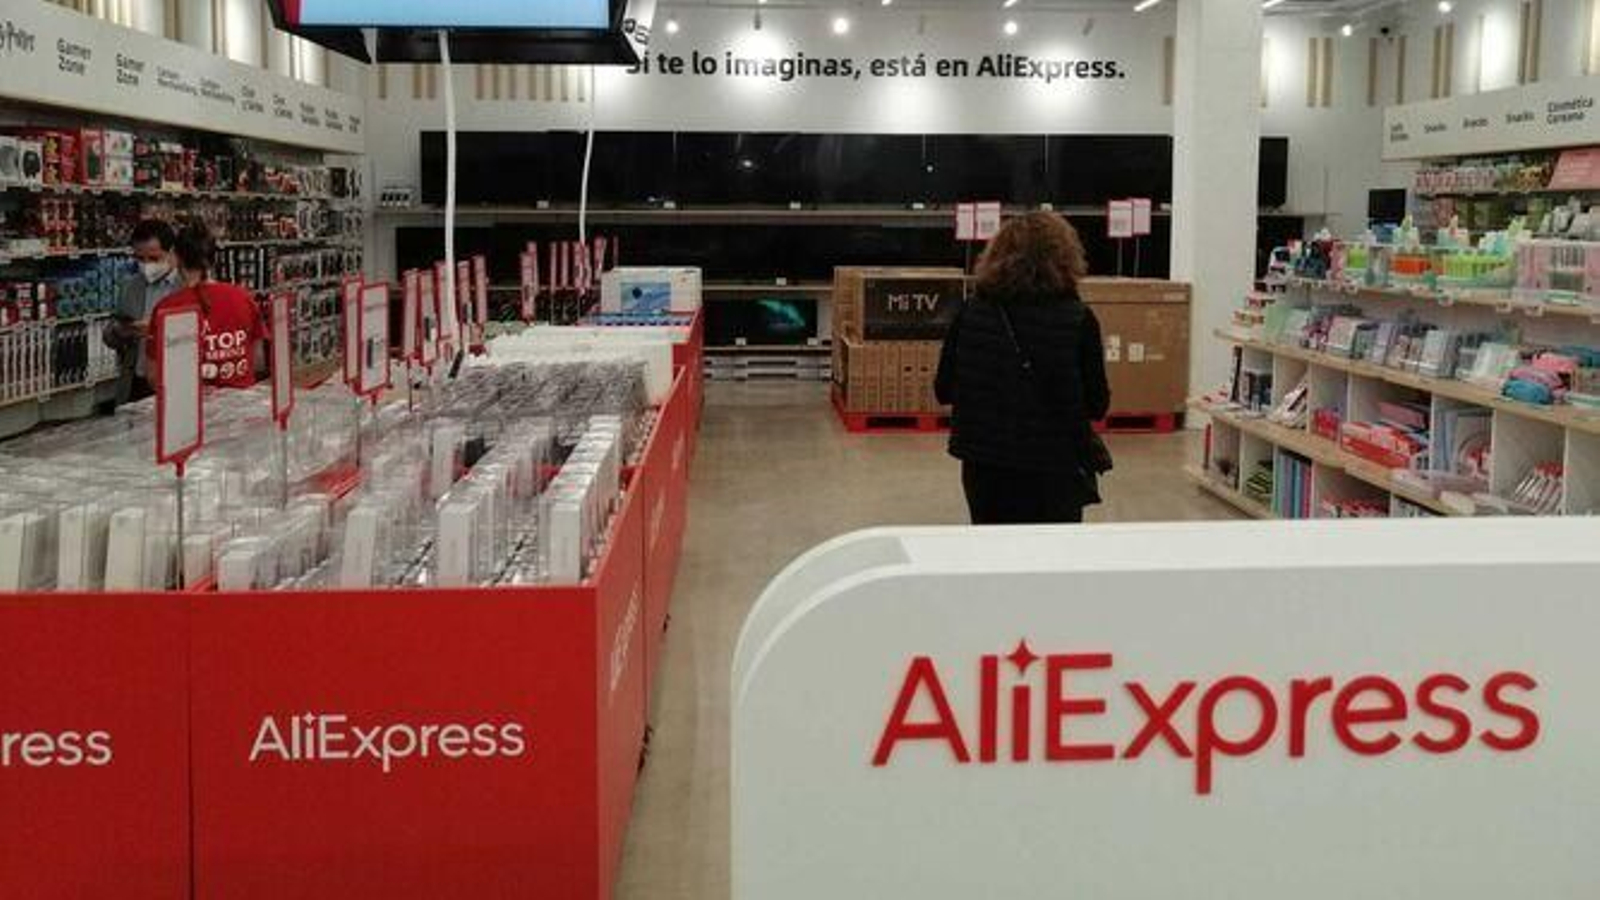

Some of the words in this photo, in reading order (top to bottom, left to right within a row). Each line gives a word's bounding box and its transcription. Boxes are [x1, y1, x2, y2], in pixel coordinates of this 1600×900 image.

[57, 38, 91, 60] Gamer
[58, 54, 85, 76] Zone
[657, 53, 684, 75] te
[692, 50, 718, 75] lo
[725, 51, 862, 82] imaginas,
[870, 54, 927, 77] está
[936, 58, 968, 77] en
[976, 54, 1126, 82] AliExpress.
[912, 294, 939, 310] TV
[205, 330, 247, 351] TOP
[872, 638, 1541, 795] AliExpress
[249, 711, 525, 773] AliExpress
